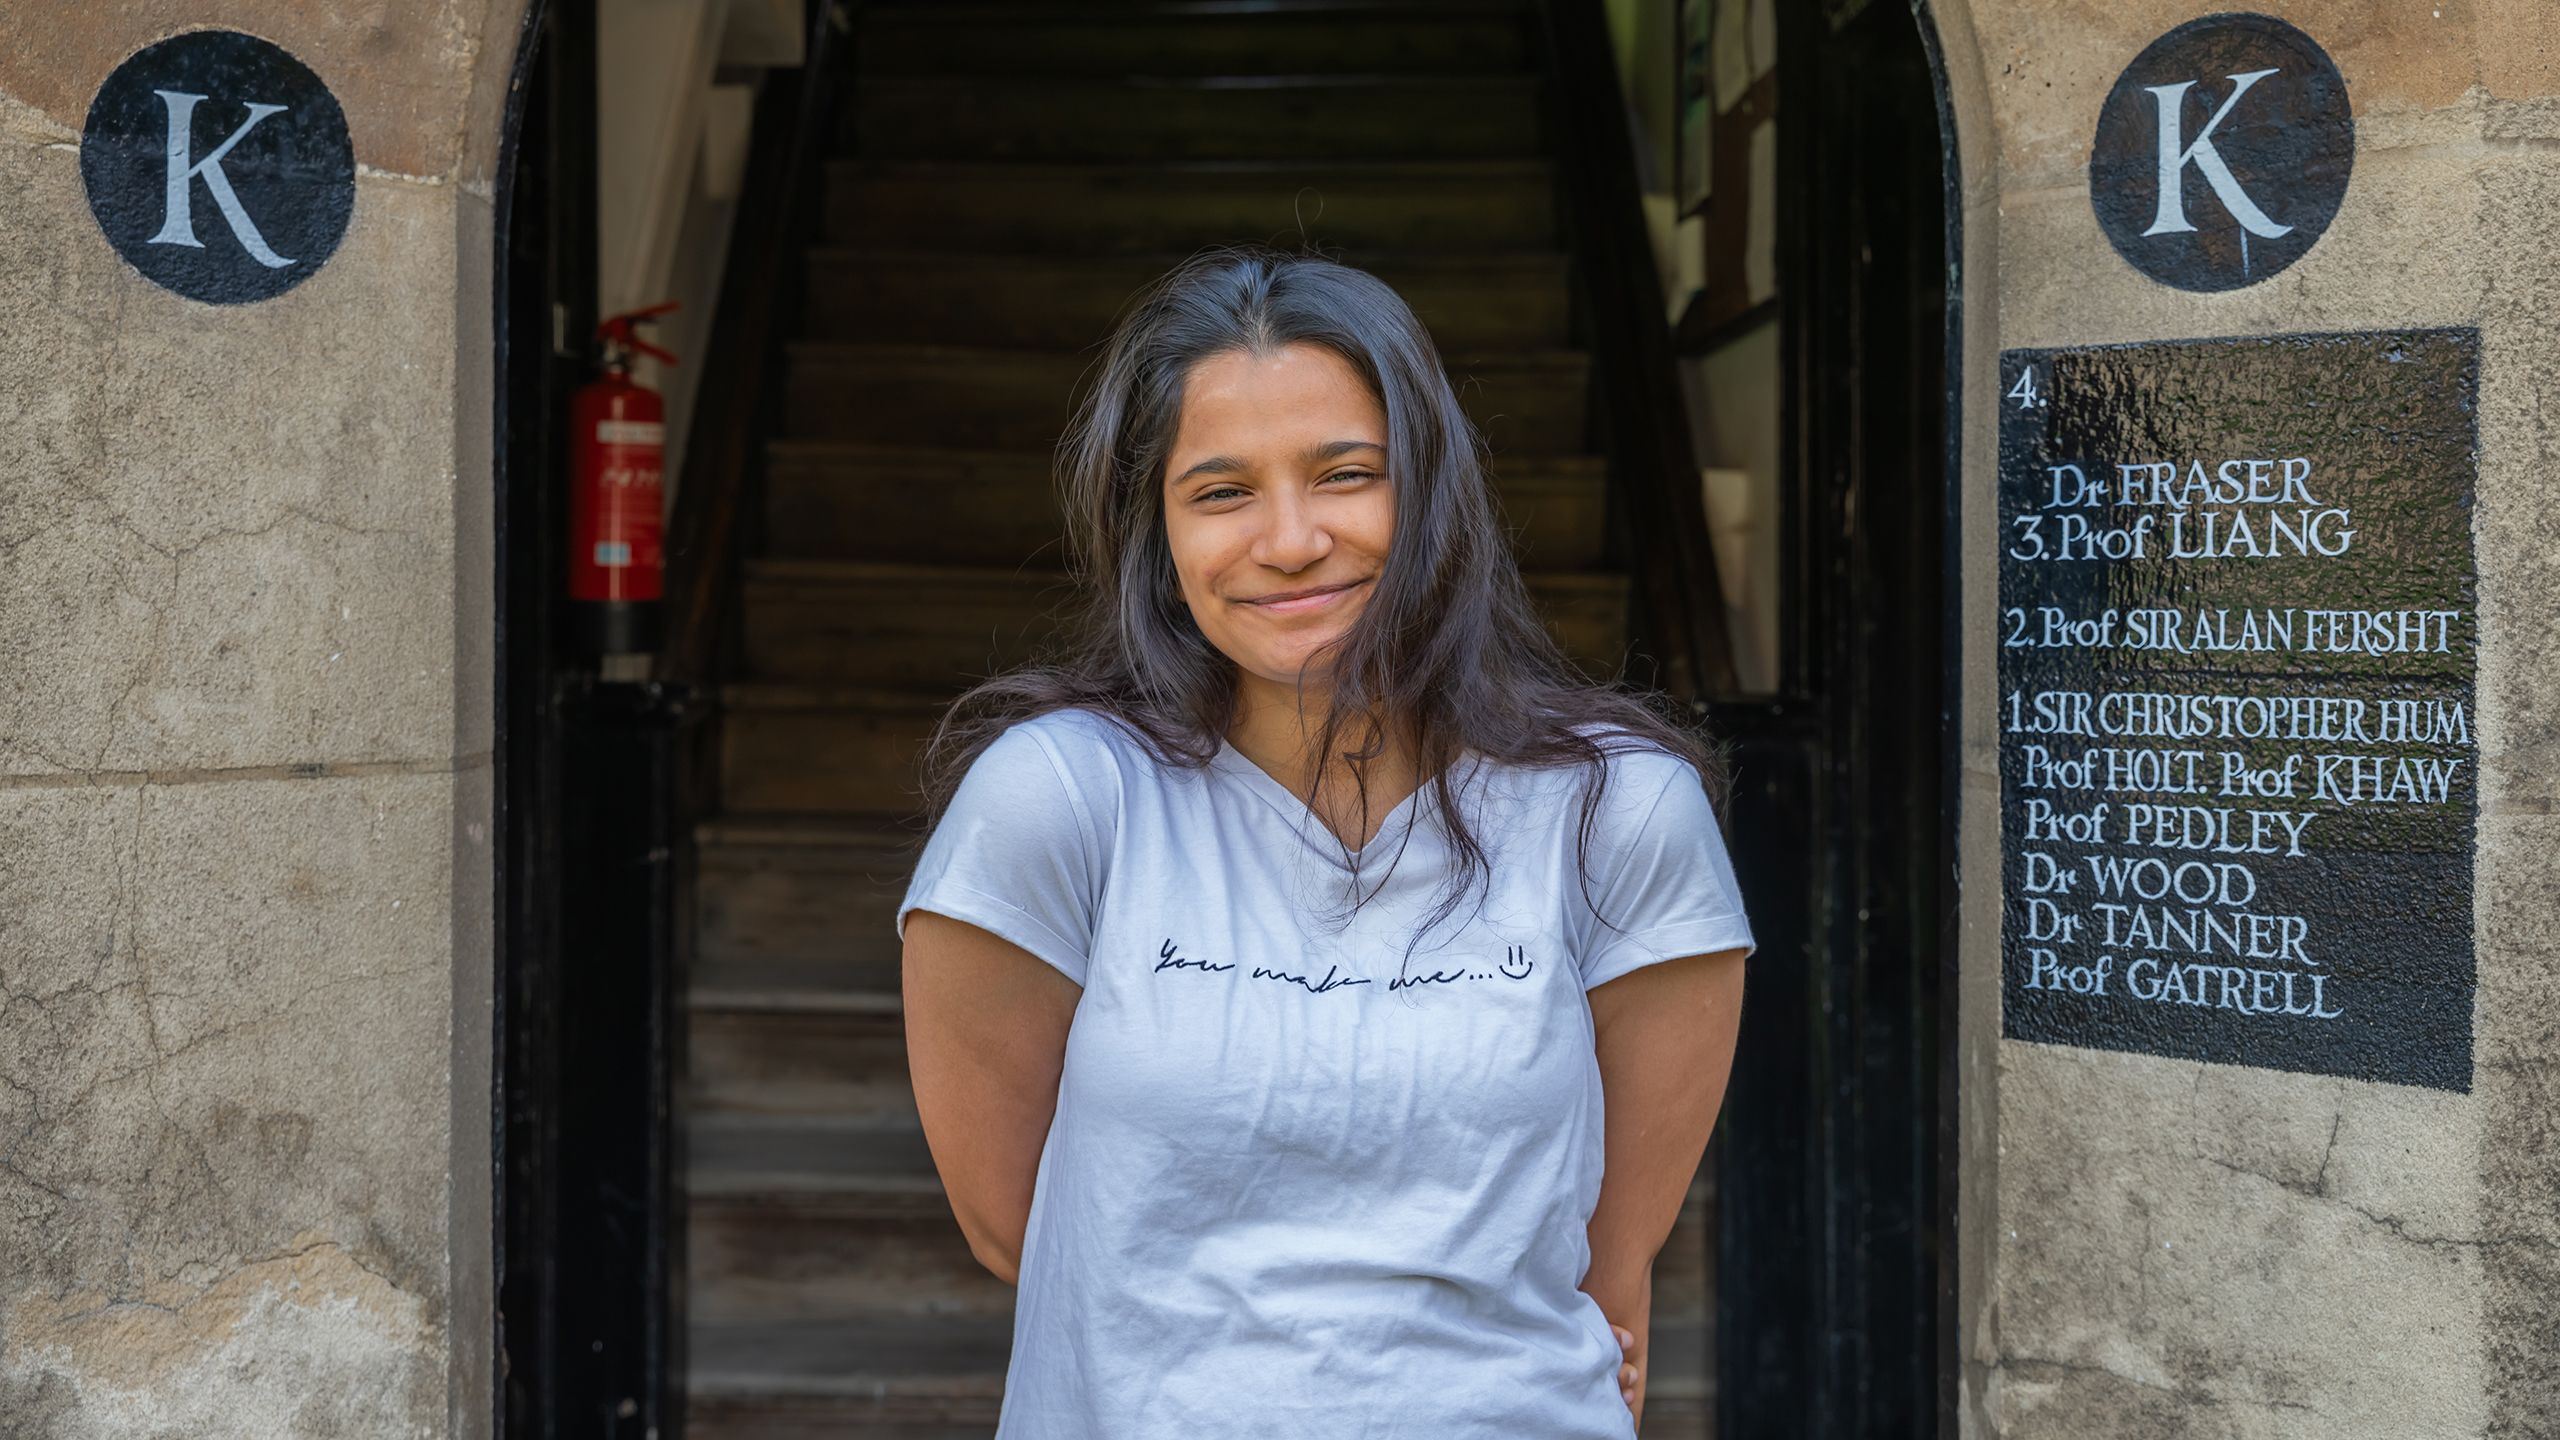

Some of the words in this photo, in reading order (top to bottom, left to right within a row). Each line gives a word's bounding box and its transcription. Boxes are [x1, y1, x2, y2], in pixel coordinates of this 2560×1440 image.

[146, 89, 298, 269] K
[2139, 67, 2294, 240] K
[2006, 365, 2047, 409] 4.
[2043, 464, 2109, 509] Dr
[2114, 457, 2322, 510] FRASER
[2165, 508, 2358, 560] LIANG
[2120, 609, 2193, 654] SIR
[2190, 608, 2296, 652] ALAN
[2301, 609, 2459, 658] FERSHT
[2098, 691, 2374, 745] CHRISTOPHER
[2374, 698, 2471, 744] HUM
[2020, 744, 2099, 790] Prof
[2217, 750, 2303, 799] Prof
[2310, 754, 2464, 806] KHAW
[2024, 799, 2110, 845] Prof
[2123, 803, 2318, 858] PEDLEY
[2021, 851, 2077, 894] Dr
[2084, 855, 2257, 907] WOOD
[2023, 899, 2084, 945] Dr
[2092, 902, 2320, 966] TANNER
[1154, 938, 1235, 974] You
[1252, 965, 1371, 993] make
[2023, 948, 2112, 997] Prof
[2127, 959, 2345, 1019] GATRELL
